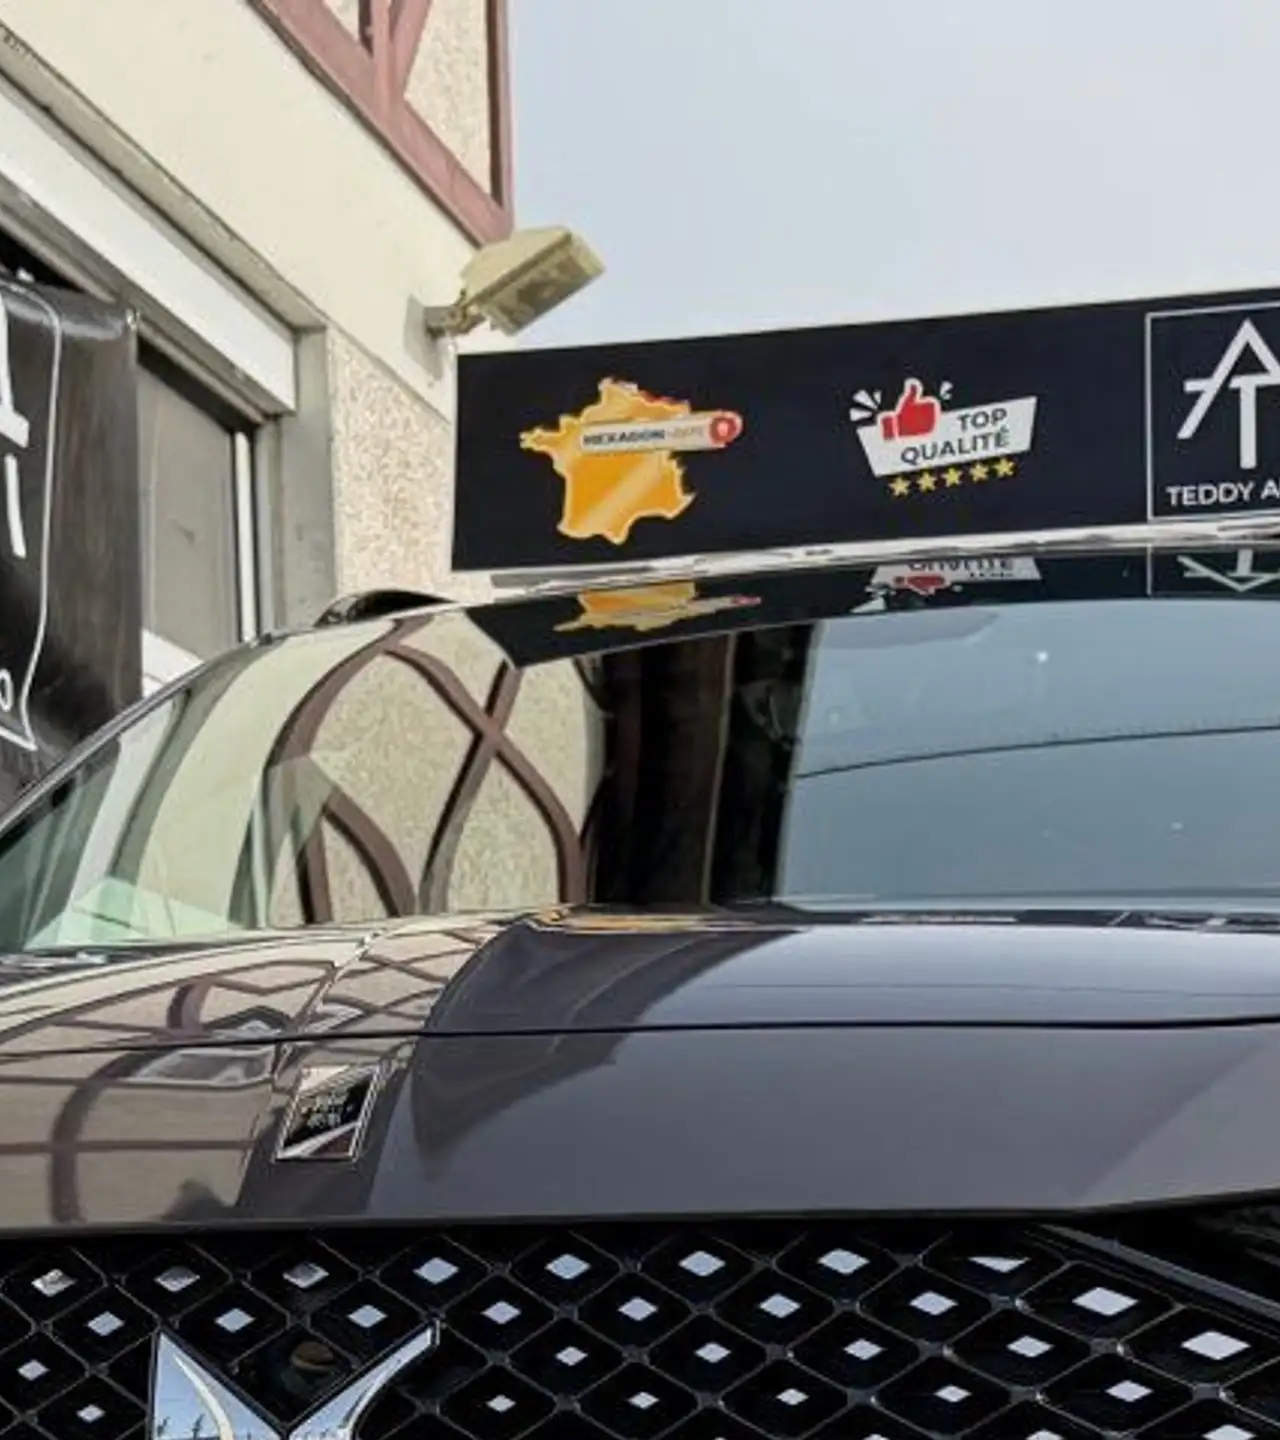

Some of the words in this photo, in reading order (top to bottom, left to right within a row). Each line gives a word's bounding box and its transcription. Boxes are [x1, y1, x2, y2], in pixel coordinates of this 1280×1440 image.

[957, 407, 1008, 433] TOP
[900, 425, 1011, 466] QUALITÉ
[1165, 481, 1255, 507] TEDDY
